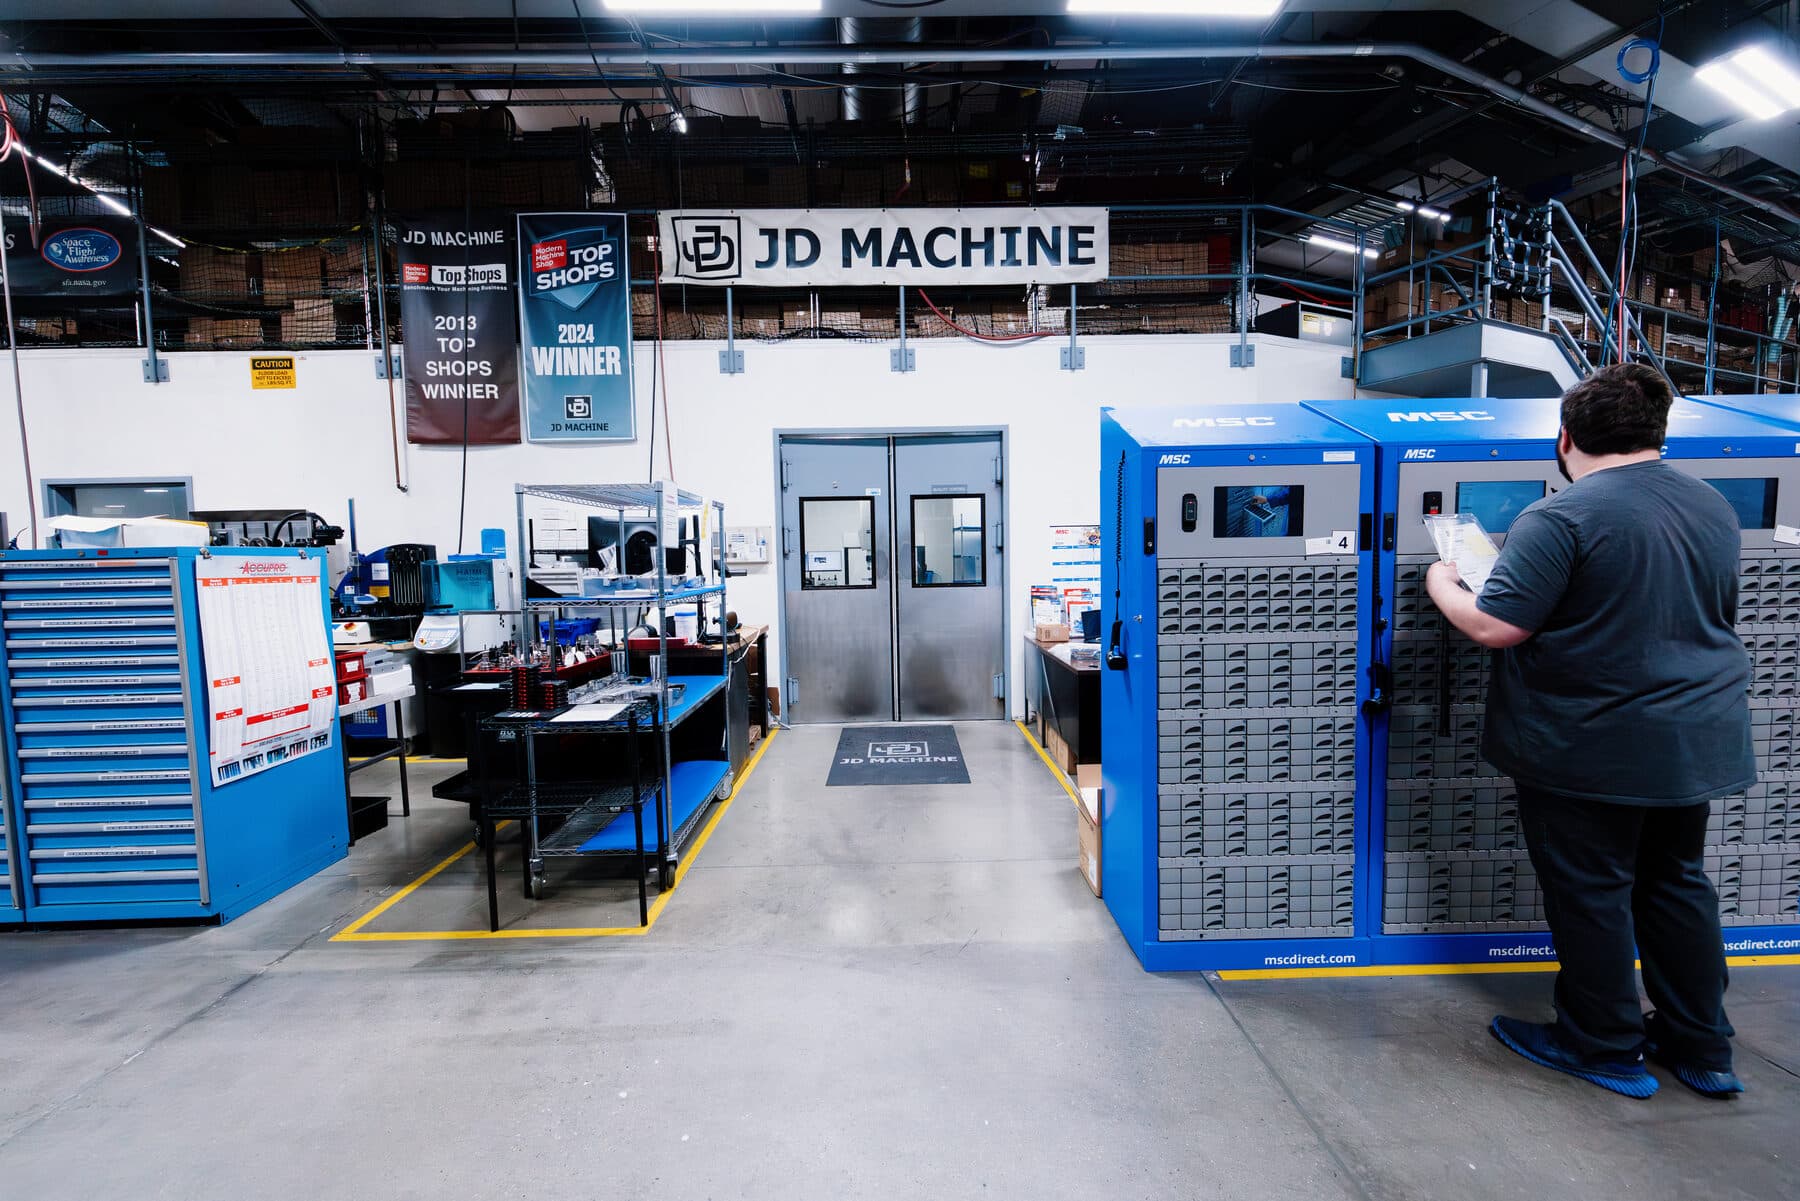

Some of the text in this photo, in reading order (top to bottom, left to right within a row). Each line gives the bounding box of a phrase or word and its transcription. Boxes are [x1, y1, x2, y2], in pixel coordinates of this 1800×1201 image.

[62, 237, 91, 248] Space
[402, 230, 505, 246] JD MACHINE
[69, 246, 97, 257] Flight
[535, 245, 563, 256] Modern
[755, 225, 1096, 269] JD MACHINE
[63, 254, 110, 264] Awareness
[535, 251, 565, 262] Machine
[569, 243, 613, 265] TOP
[535, 259, 554, 268] Shop
[438, 268, 502, 285] Top Shops
[536, 261, 615, 290] SHOPS
[62, 279, 107, 288] sfa.nasa.gov
[434, 315, 477, 331] 2013
[558, 323, 595, 344] 2024
[436, 337, 476, 353] TOP
[531, 345, 622, 376] WINNER
[425, 360, 493, 377] SHOPS
[421, 383, 499, 400] WINNER
[1172, 416, 1277, 428] MSC
[1387, 410, 1497, 422] MSC
[550, 422, 609, 432] JD MACHINE
[1159, 454, 1192, 465] MSC
[1403, 448, 1437, 459] MSC
[1338, 536, 1349, 549] 4
[241, 561, 288, 574] ACCUPRO
[869, 756, 959, 764] MACHINE
[1264, 954, 1356, 965] mscdirect.com
